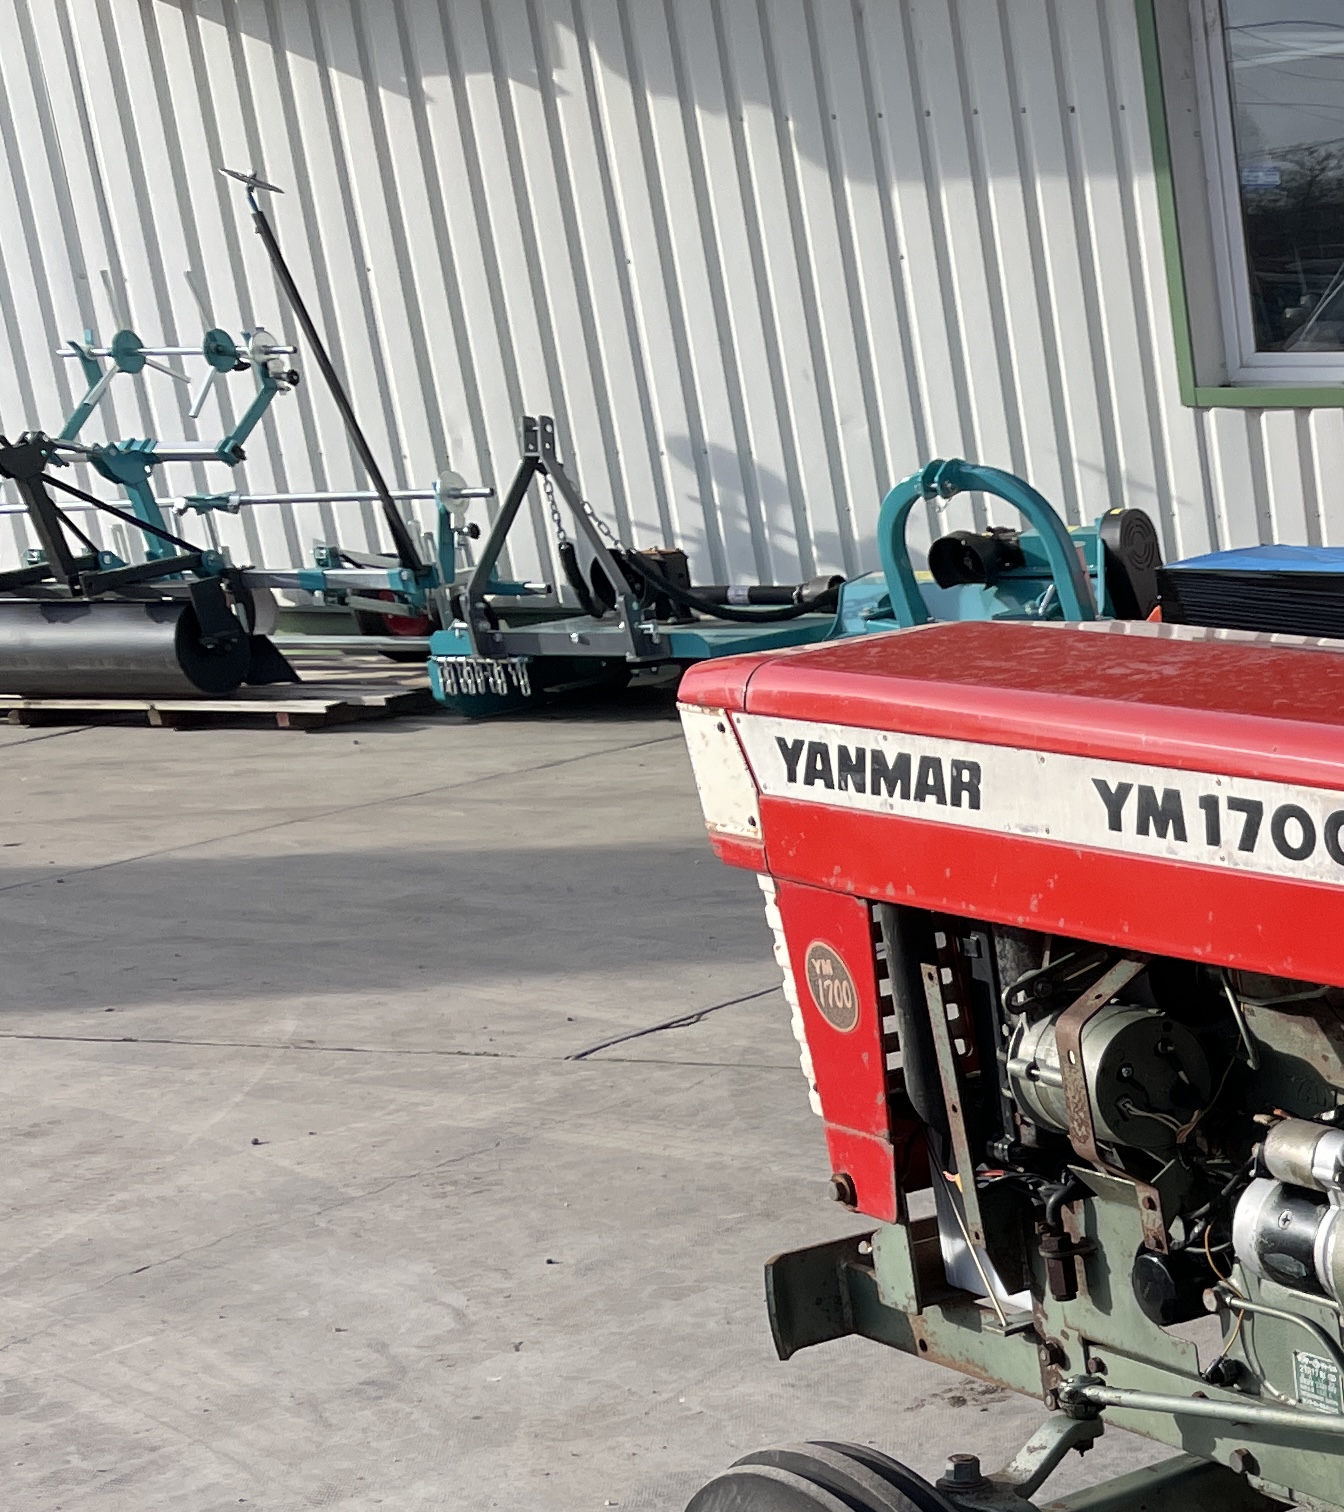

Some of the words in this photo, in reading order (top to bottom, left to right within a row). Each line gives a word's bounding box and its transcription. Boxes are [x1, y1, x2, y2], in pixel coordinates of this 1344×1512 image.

[775, 736, 981, 810] YANMAR
[811, 959, 833, 975] YM
[819, 979, 852, 1008] 1700
